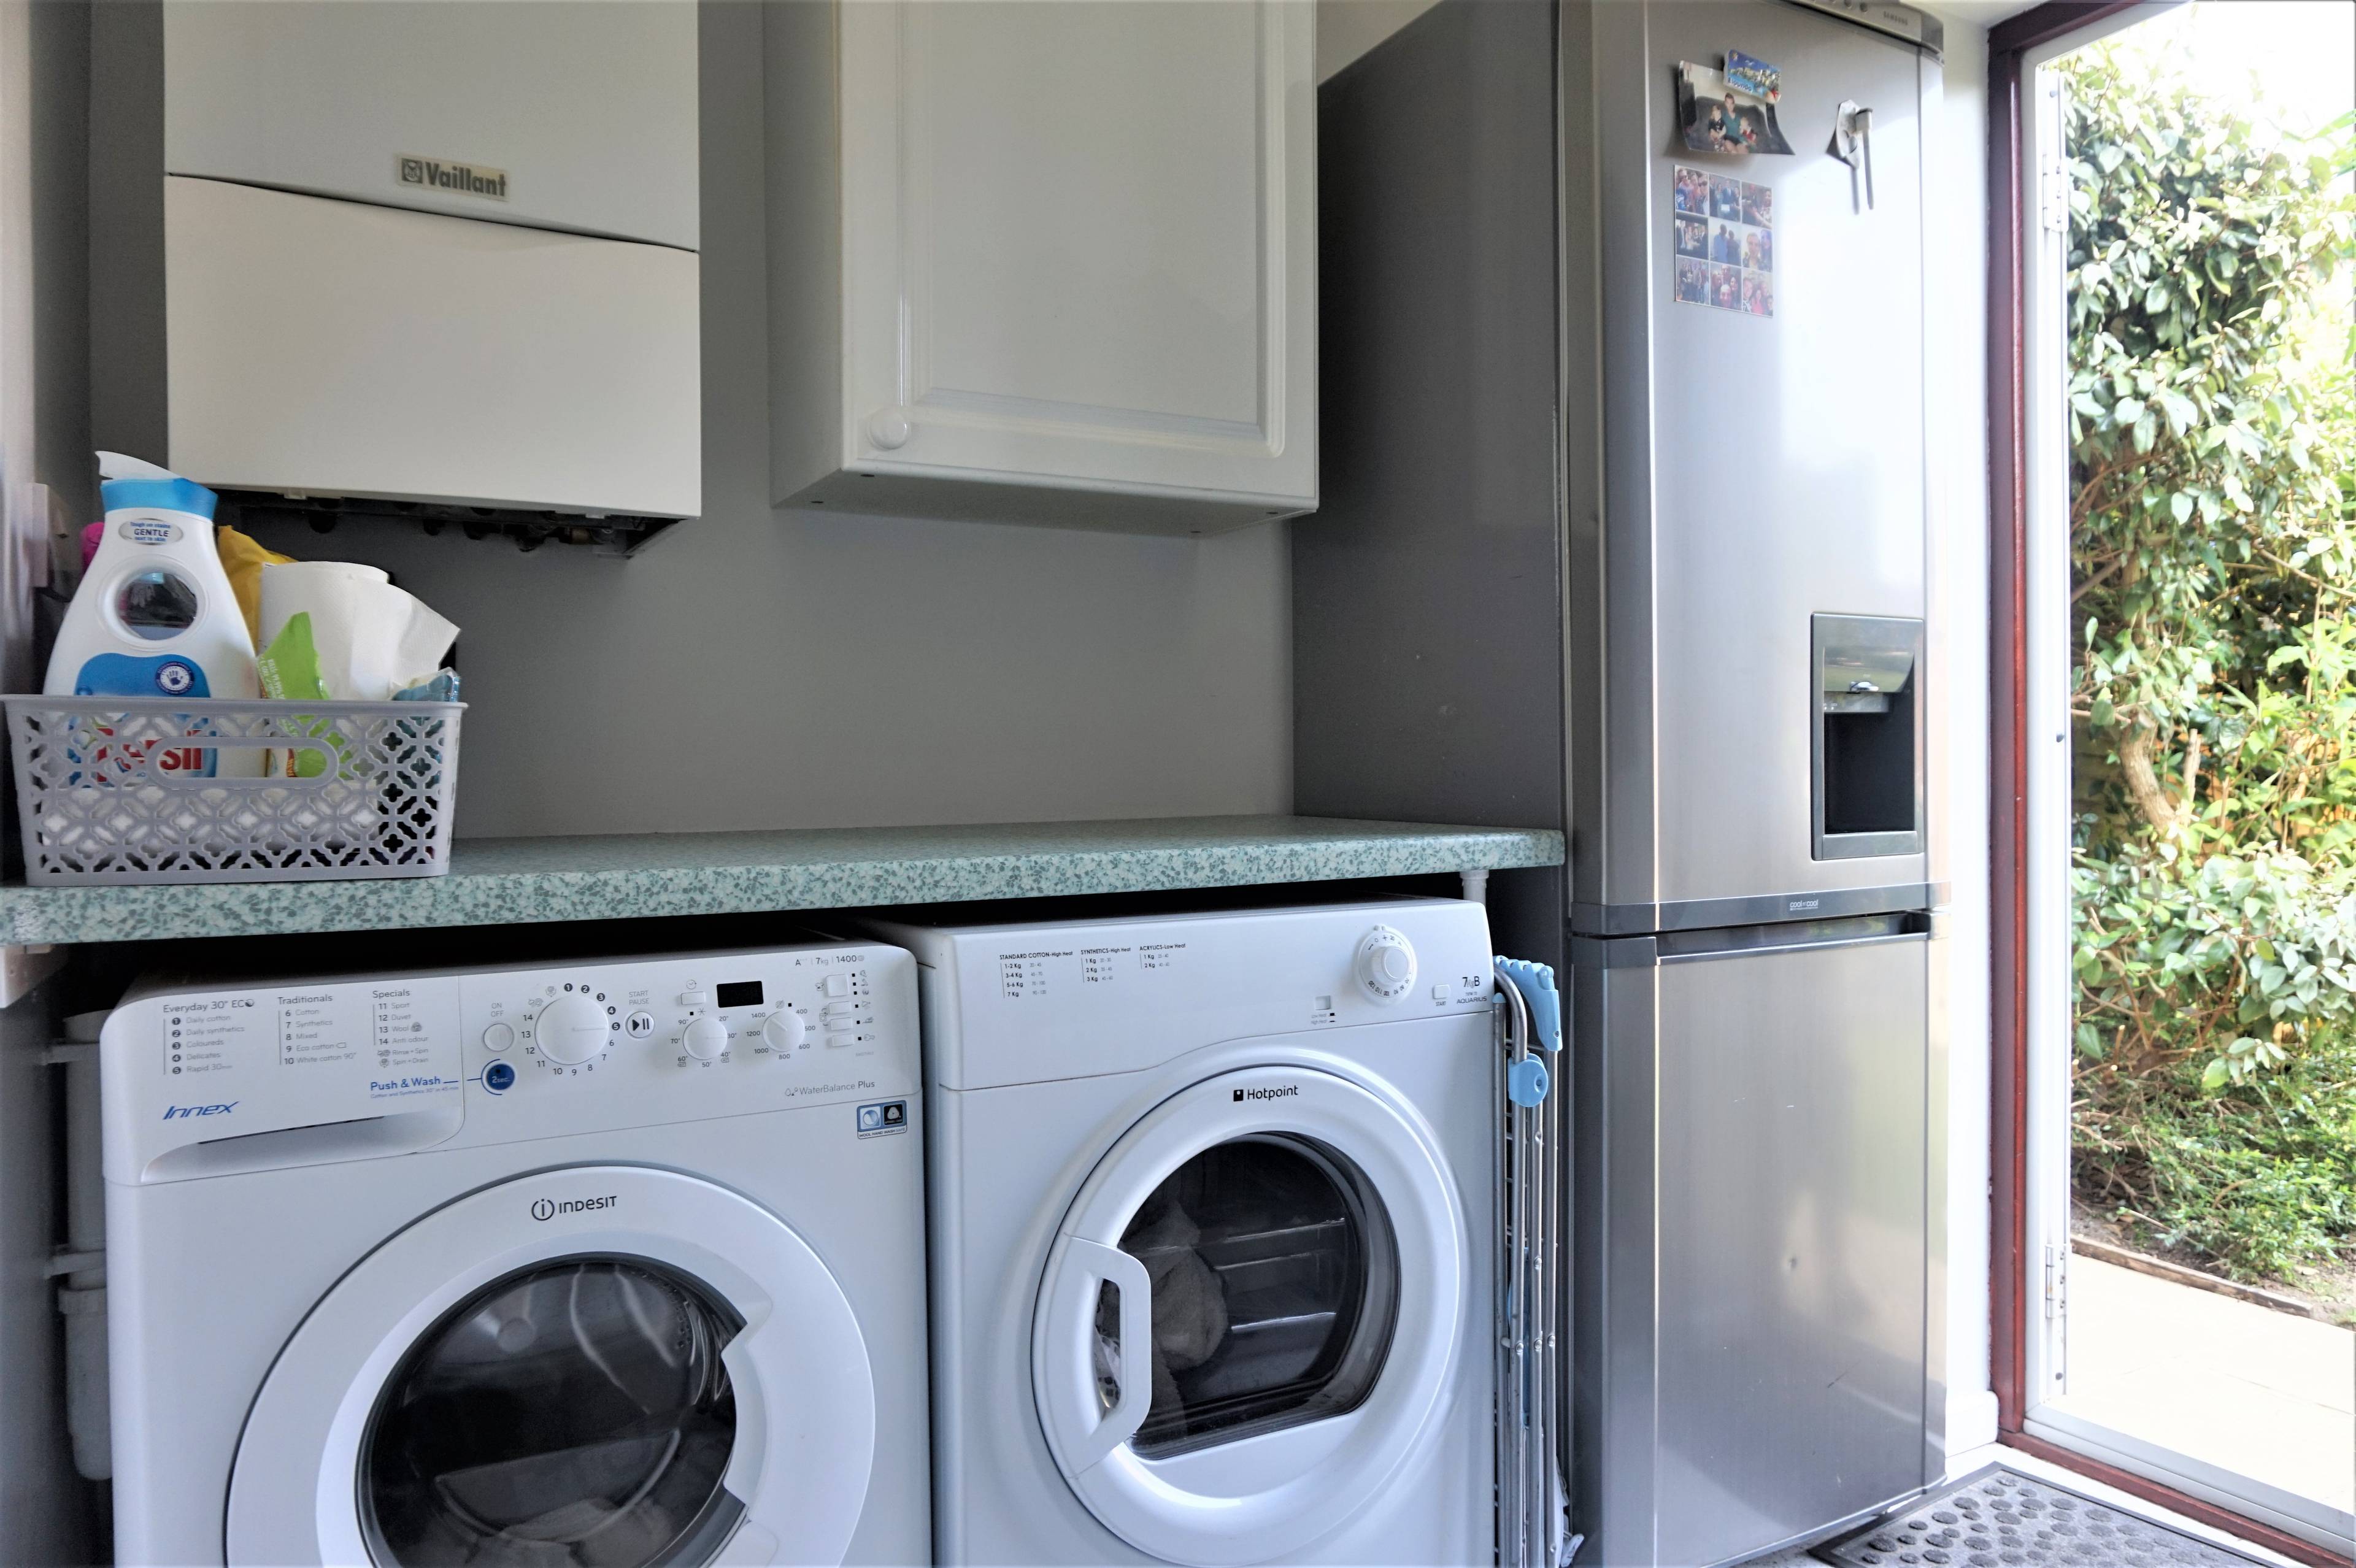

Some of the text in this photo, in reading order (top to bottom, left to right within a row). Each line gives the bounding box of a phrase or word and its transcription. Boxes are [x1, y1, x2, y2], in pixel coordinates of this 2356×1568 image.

[425, 161, 506, 196] Vaillant
[134, 528, 169, 537] GENTLE
[277, 994, 333, 1004] Traditionals
[372, 989, 410, 999] Specials
[163, 1003, 208, 1013] Everyday
[206, 1026, 245, 1035] synthetics
[187, 1039, 224, 1048] Coloureds
[371, 1076, 441, 1091] Push & Wash
[799, 1083, 855, 1095] WaterBalance
[1247, 1085, 1298, 1101] Hotpoint
[163, 1101, 239, 1120] Innex
